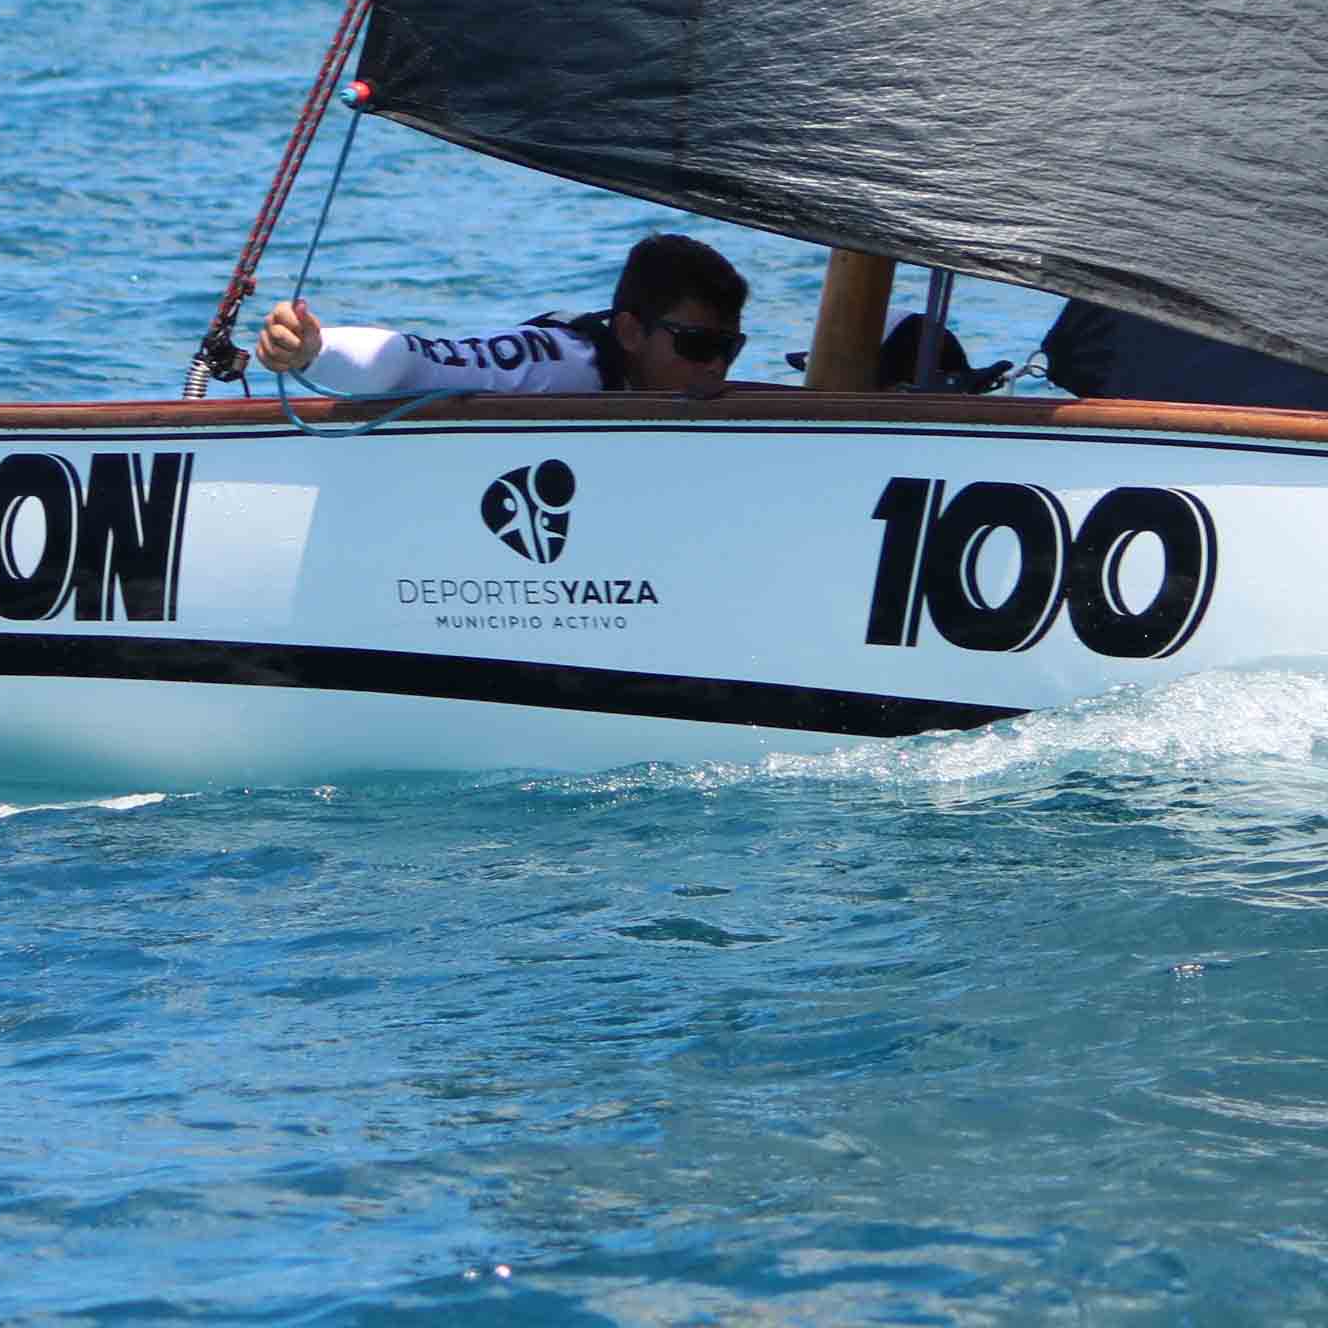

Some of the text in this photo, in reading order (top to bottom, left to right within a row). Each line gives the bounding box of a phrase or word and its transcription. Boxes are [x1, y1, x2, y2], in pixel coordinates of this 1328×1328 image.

[864, 476, 1218, 660] 100
[435, 615, 628, 630] MUNICIPIO ACTIVO
